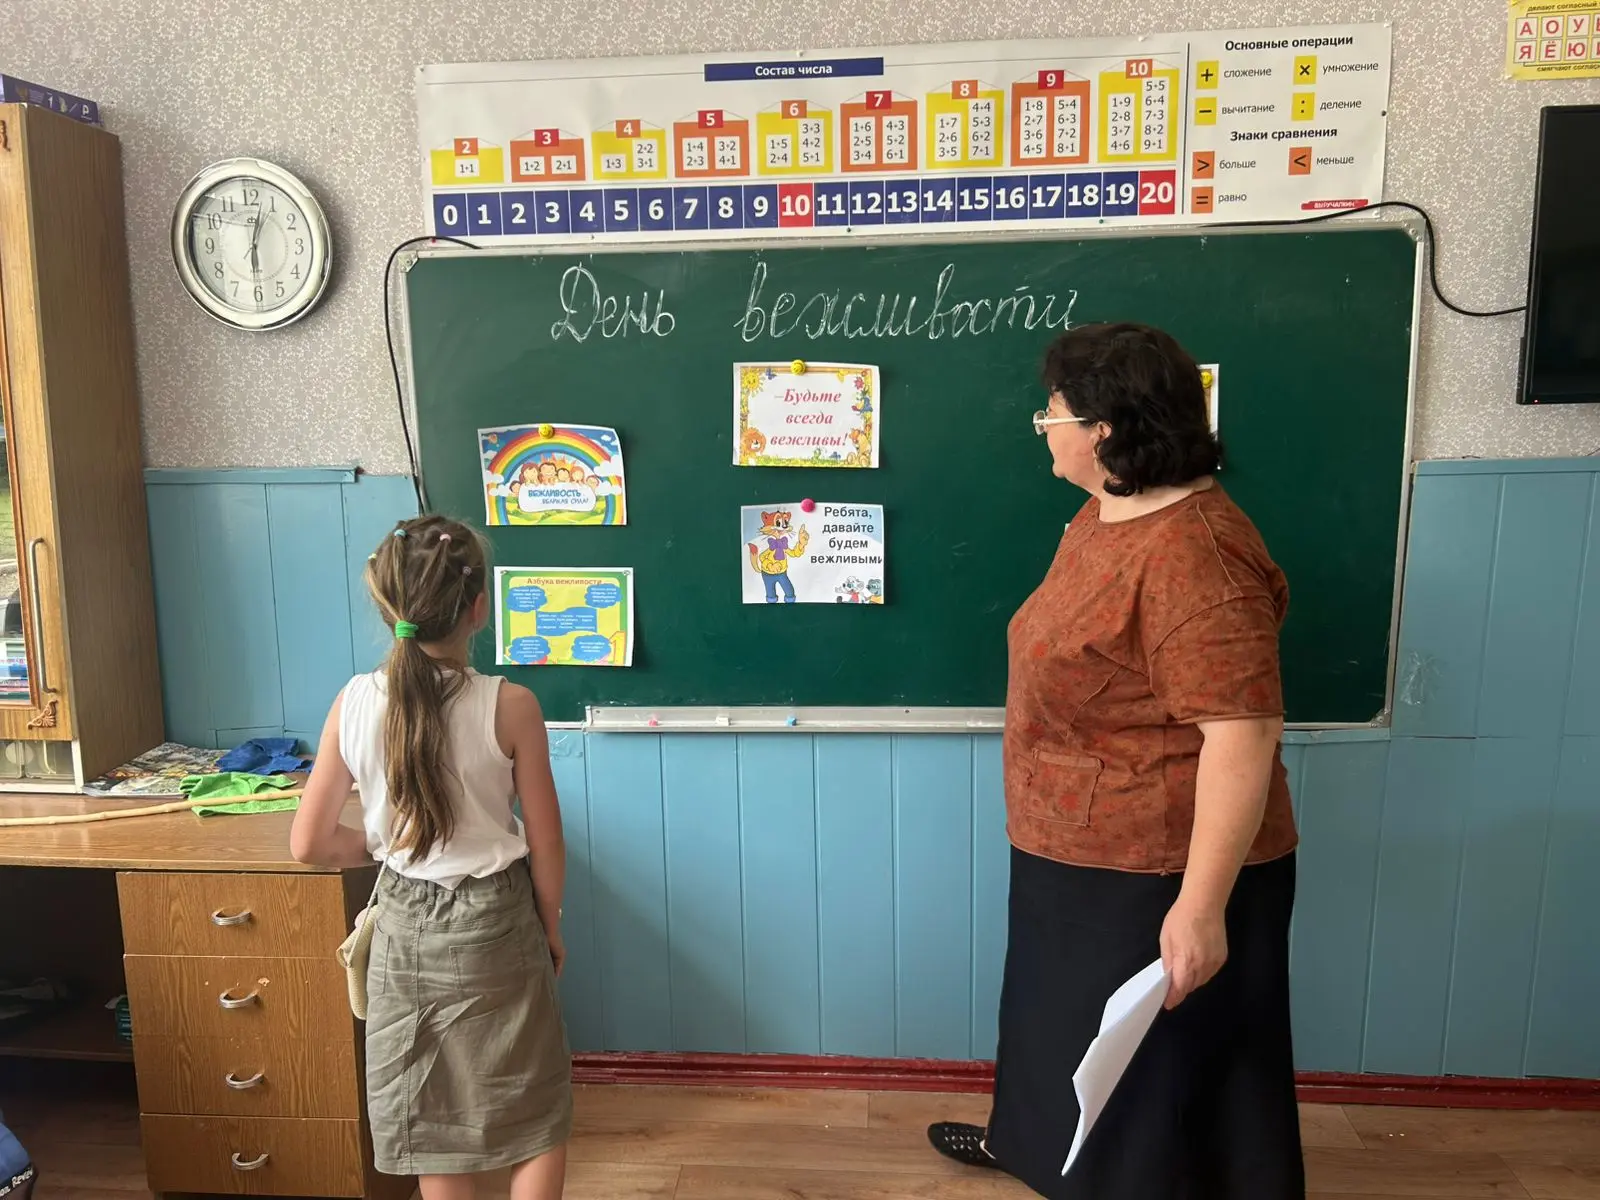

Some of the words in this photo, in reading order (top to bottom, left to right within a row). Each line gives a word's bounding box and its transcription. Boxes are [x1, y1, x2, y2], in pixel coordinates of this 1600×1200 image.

[1520, 22, 1532, 35] А
[1546, 20, 1559, 34] О
[1574, 18, 1584, 33] У
[1225, 40, 1288, 50] Основные
[1292, 36, 1353, 48] операции
[1518, 45, 1532, 60] Я
[1544, 40, 1556, 58] Ё
[1567, 42, 1586, 57] Ю
[754, 66, 795, 76] Состав
[798, 64, 833, 75] числа
[1130, 62, 1148, 76] 10
[1224, 68, 1272, 78] сложение
[1322, 62, 1379, 74] умножение
[1046, 73, 1056, 87] 9
[960, 83, 970, 96] 8
[874, 94, 884, 106] 7
[1320, 100, 1362, 111] деление
[789, 103, 800, 116] 6
[1222, 104, 1275, 114] вычитание
[706, 113, 716, 126] 5
[623, 122, 633, 135] 4
[1230, 130, 1268, 142] Знаки
[1272, 128, 1338, 141] сравнения
[542, 132, 552, 144] 3
[461, 141, 471, 154] 2
[1219, 160, 1256, 169] больше
[1316, 156, 1354, 165] меньше
[242, 188, 259, 206] 12
[1218, 194, 1248, 204] равно
[221, 196, 234, 212] 11
[270, 196, 276, 212] 1
[442, 205, 458, 226] 0
[478, 204, 492, 224] 1
[511, 203, 527, 224] 2
[545, 202, 560, 223] 3
[580, 201, 596, 222] 4
[614, 200, 629, 221] 5
[648, 200, 664, 220] 6
[684, 198, 698, 219] 7
[718, 198, 734, 218] 8
[752, 196, 769, 217] 9
[781, 196, 810, 216] 10
[817, 194, 845, 215] 11
[852, 193, 882, 214] 12
[887, 191, 918, 212] 13
[924, 190, 954, 211] 14
[960, 189, 989, 210] 15
[996, 188, 1026, 208] 16
[1032, 187, 1062, 207] 17
[1068, 185, 1099, 206] 18
[1105, 184, 1135, 205] 19
[1141, 182, 1174, 203] 20
[207, 213, 222, 230] 10
[287, 213, 296, 230] 2
[205, 237, 215, 254] 9
[295, 238, 304, 255] 3
[214, 262, 224, 279] 8
[290, 263, 300, 279] 4
[230, 281, 240, 298] 7
[254, 286, 263, 302] 6
[275, 282, 285, 298] 5
[551, 261, 677, 343] День
[786, 412, 834, 424] всегда
[770, 433, 848, 446] вежливы!
[824, 507, 872, 519] Ребята,
[822, 523, 874, 534] давайте
[828, 537, 868, 550] будем
[527, 578, 554, 586] Азбука
[556, 578, 602, 586] вежливости
